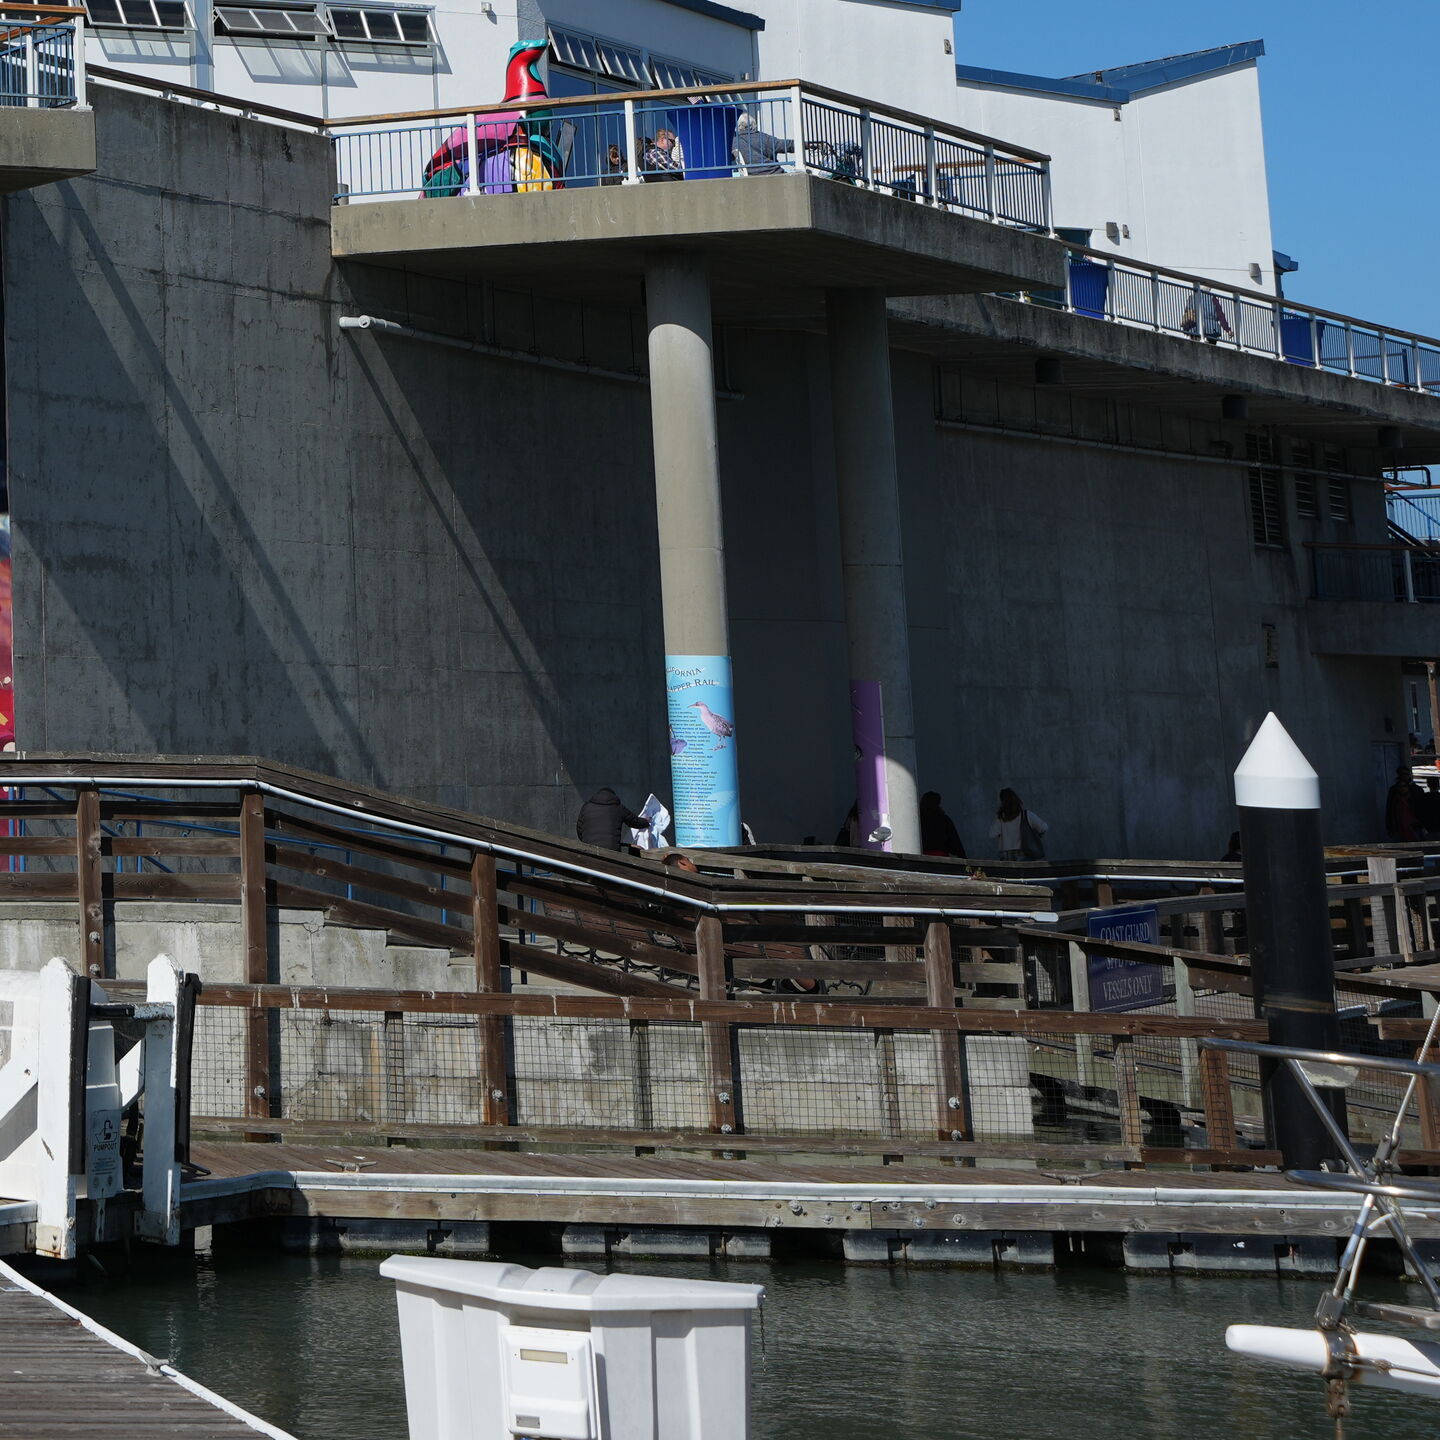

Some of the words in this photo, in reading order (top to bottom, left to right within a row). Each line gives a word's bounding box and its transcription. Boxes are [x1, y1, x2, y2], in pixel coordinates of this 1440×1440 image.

[694, 678, 716, 687] RAIL
[1100, 925, 1124, 942] COAST
[1124, 922, 1150, 942] GUARD
[1102, 977, 1133, 1001] VESSELS
[1133, 974, 1153, 997] ONLY
